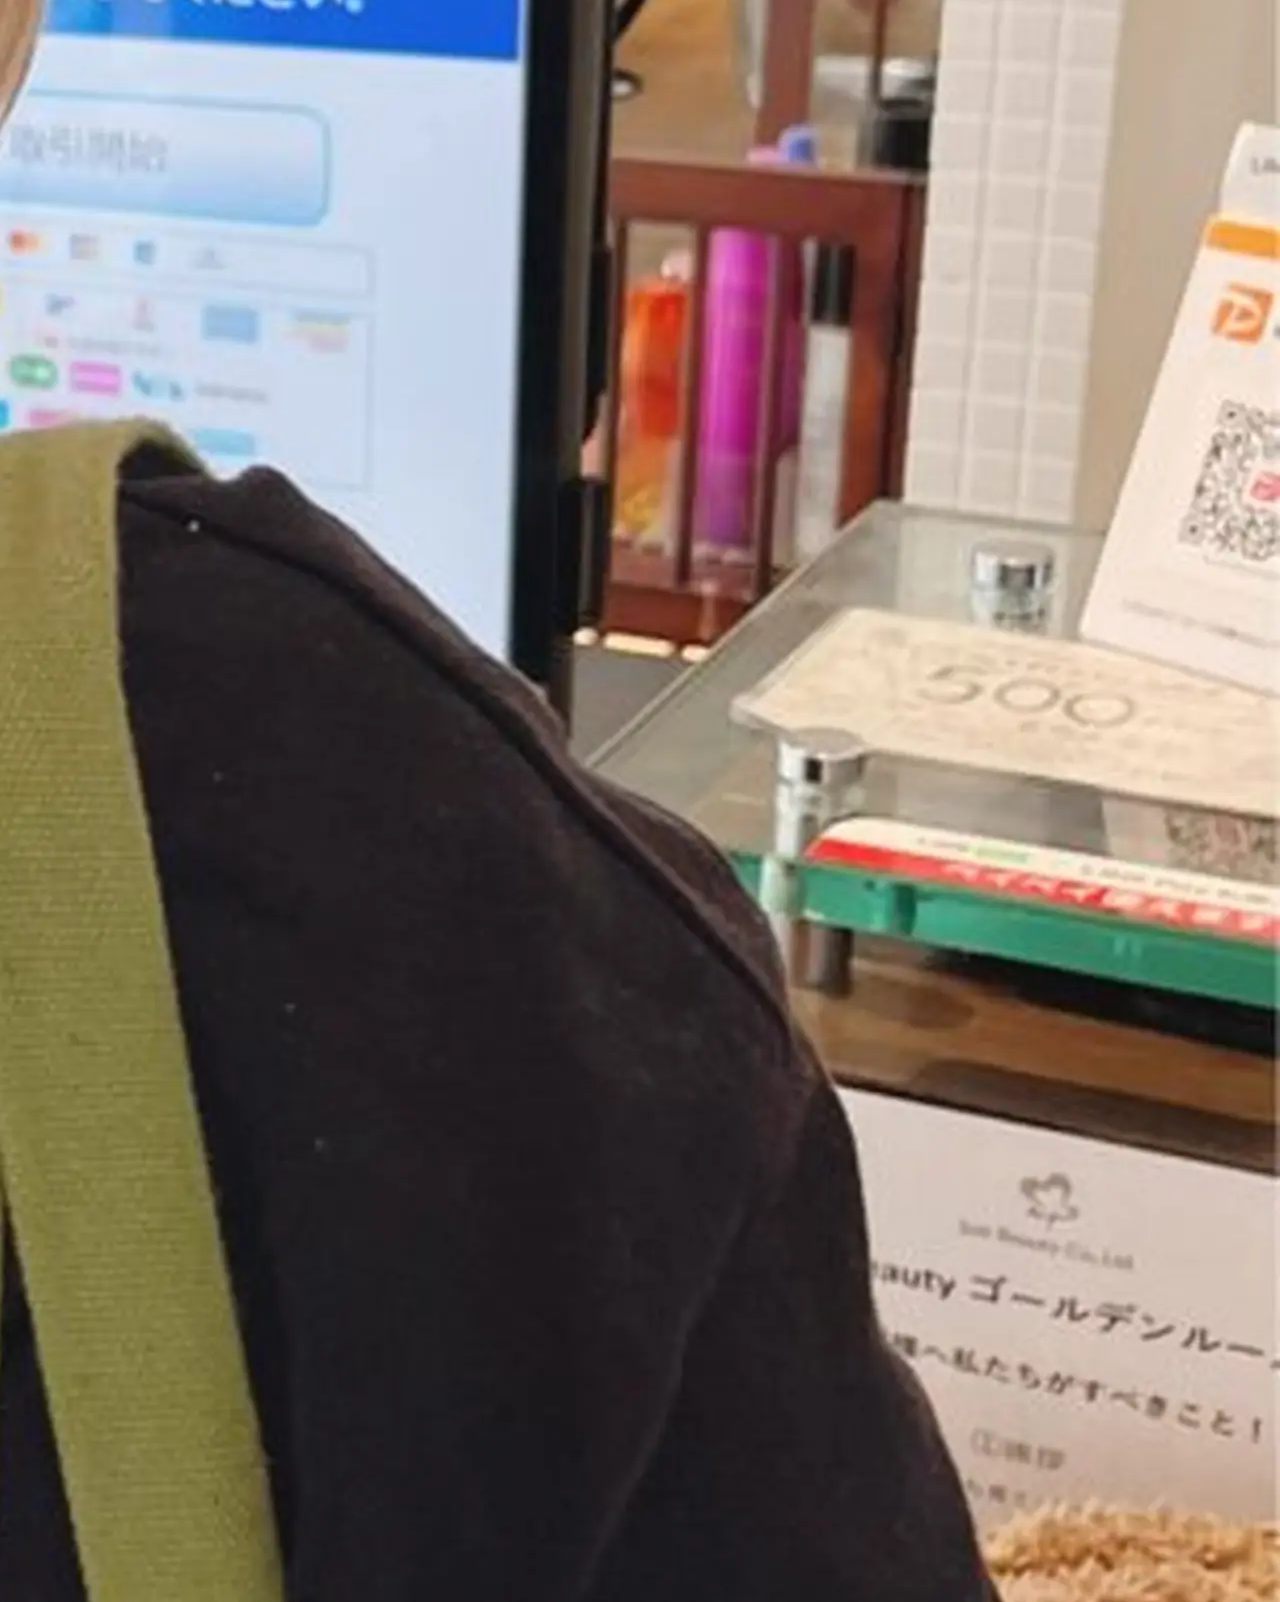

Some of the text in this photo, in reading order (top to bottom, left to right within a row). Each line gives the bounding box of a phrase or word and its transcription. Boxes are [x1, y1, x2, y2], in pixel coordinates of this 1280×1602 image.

[916, 663, 1135, 729] 500
[969, 1275, 1279, 1369] ゴールデンルー
